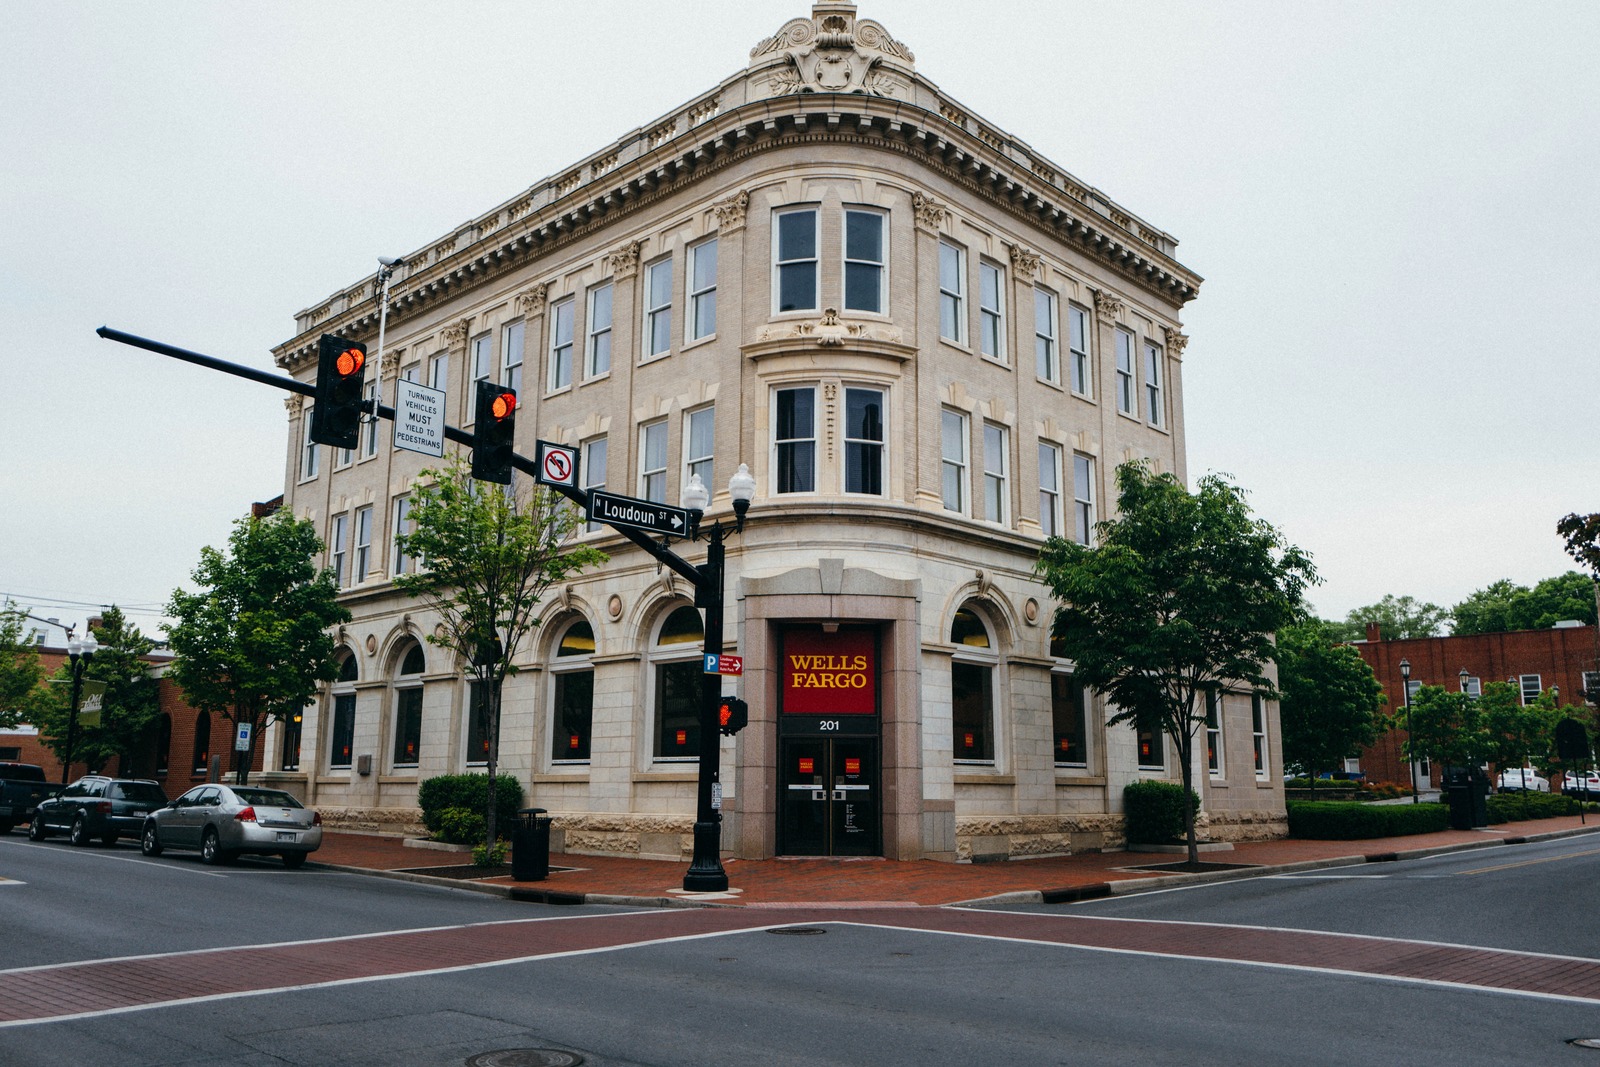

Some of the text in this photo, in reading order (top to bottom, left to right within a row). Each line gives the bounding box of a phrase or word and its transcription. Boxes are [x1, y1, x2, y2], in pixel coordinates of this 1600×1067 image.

[408, 390, 436, 404] TURNING
[405, 400, 437, 415] VEHICLES
[408, 412, 432, 426] MUST
[405, 423, 435, 437] YIELD TO
[397, 432, 441, 450] PEDESTRIANS
[596, 498, 667, 525] N Loudoun ST
[707, 656, 716, 670] P
[790, 655, 868, 670] WELLS
[792, 673, 867, 688] FARGO
[820, 720, 840, 730] 201
